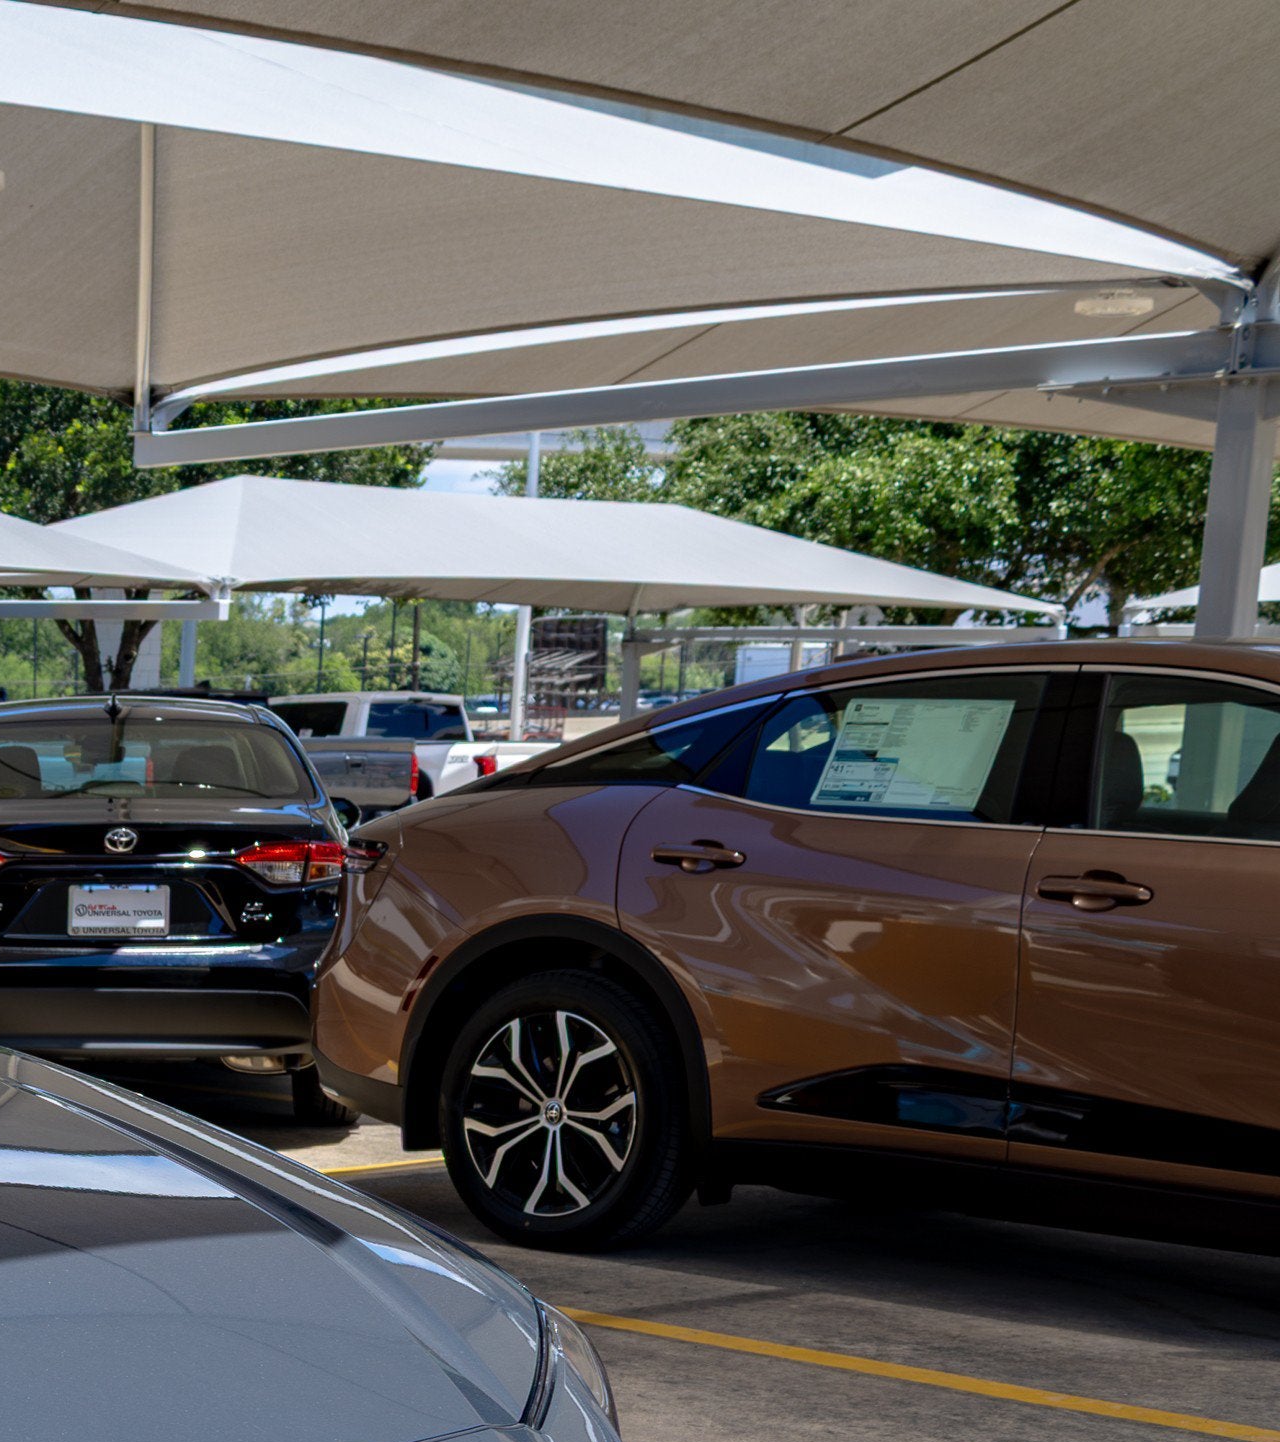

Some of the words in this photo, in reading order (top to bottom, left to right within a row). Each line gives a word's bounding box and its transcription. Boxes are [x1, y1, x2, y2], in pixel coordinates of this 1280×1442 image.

[87, 909, 131, 917] UNIVERSAL
[134, 909, 162, 917] TOYOTA
[83, 926, 130, 934] UNIVERSAL
[134, 926, 165, 934] TOYOTA
